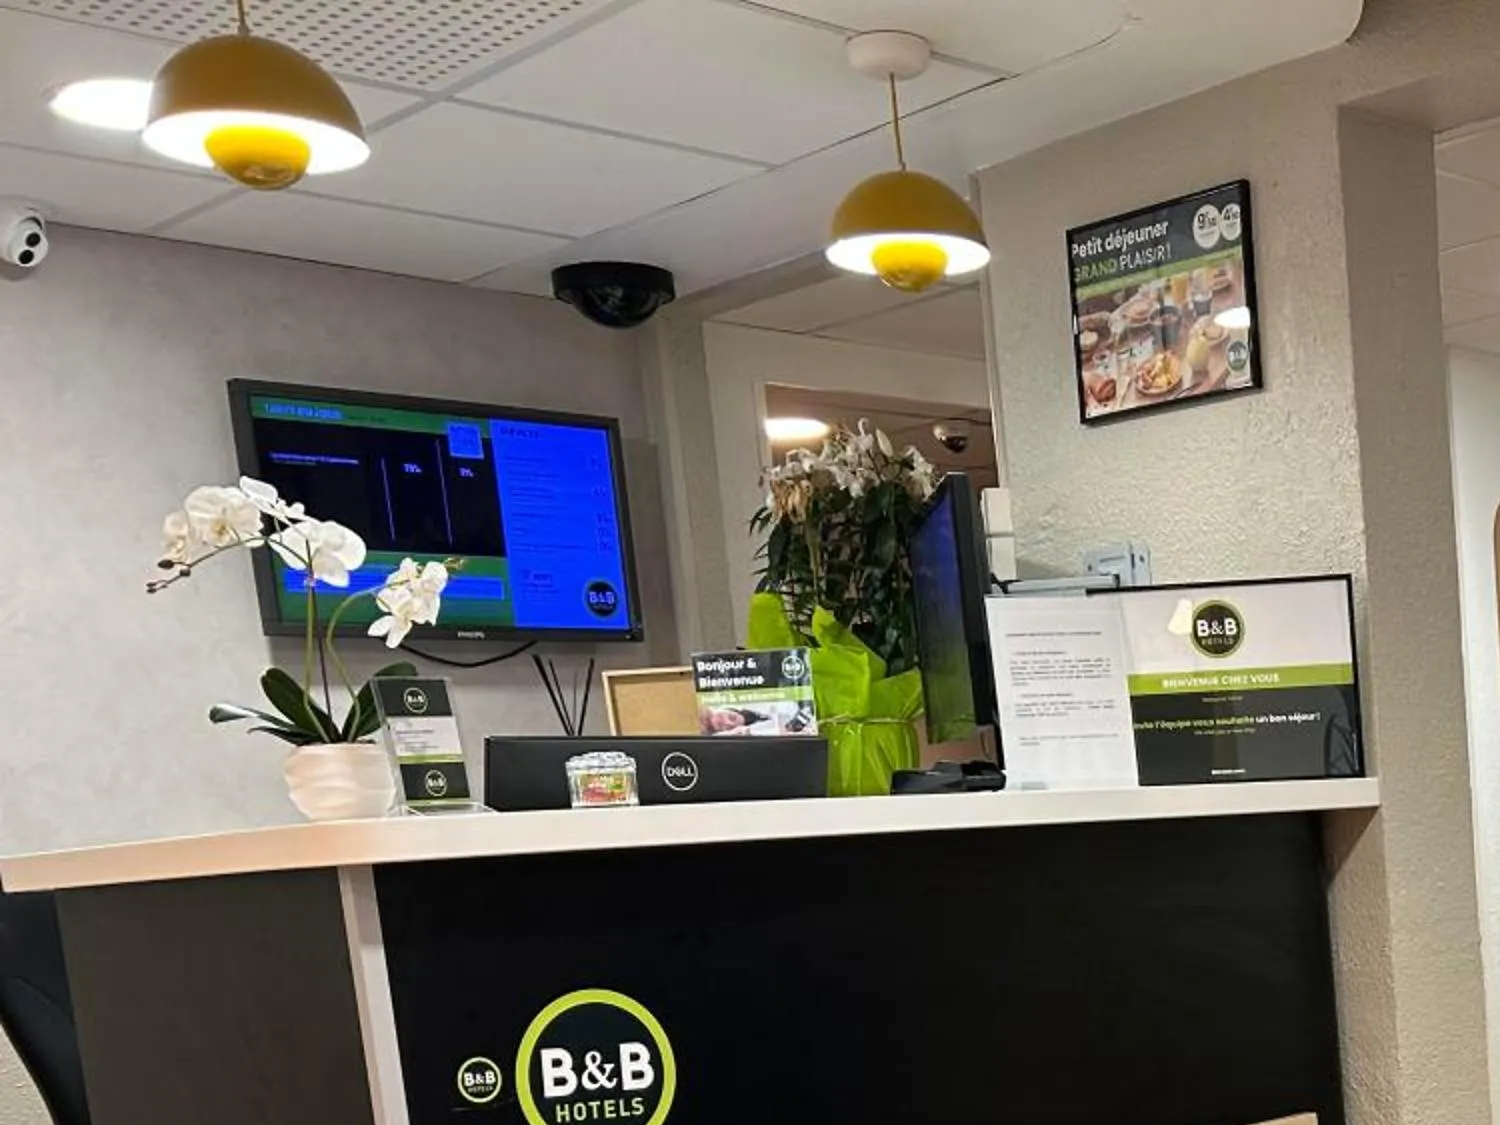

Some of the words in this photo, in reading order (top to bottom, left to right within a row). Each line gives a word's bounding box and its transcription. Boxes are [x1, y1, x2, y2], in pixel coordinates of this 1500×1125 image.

[1071, 236, 1103, 258] Petit
[1104, 221, 1169, 253] déjeuner
[1196, 617, 1238, 637] B&B
[696, 660, 744, 673] Bonjour
[747, 658, 757, 669] &
[698, 675, 765, 689] Bienvenue
[1162, 677, 1219, 689] BIENVENUE
[1221, 674, 1248, 685] CHEZ
[1250, 672, 1281, 684] VOUS
[1193, 718, 1214, 728] vous
[1256, 715, 1268, 724] un
[1269, 713, 1287, 724] bon
[667, 766, 695, 778] DELL
[464, 1070, 497, 1087] B&B
[540, 1041, 655, 1099] B&B
[555, 1097, 645, 1124] HOTELS
